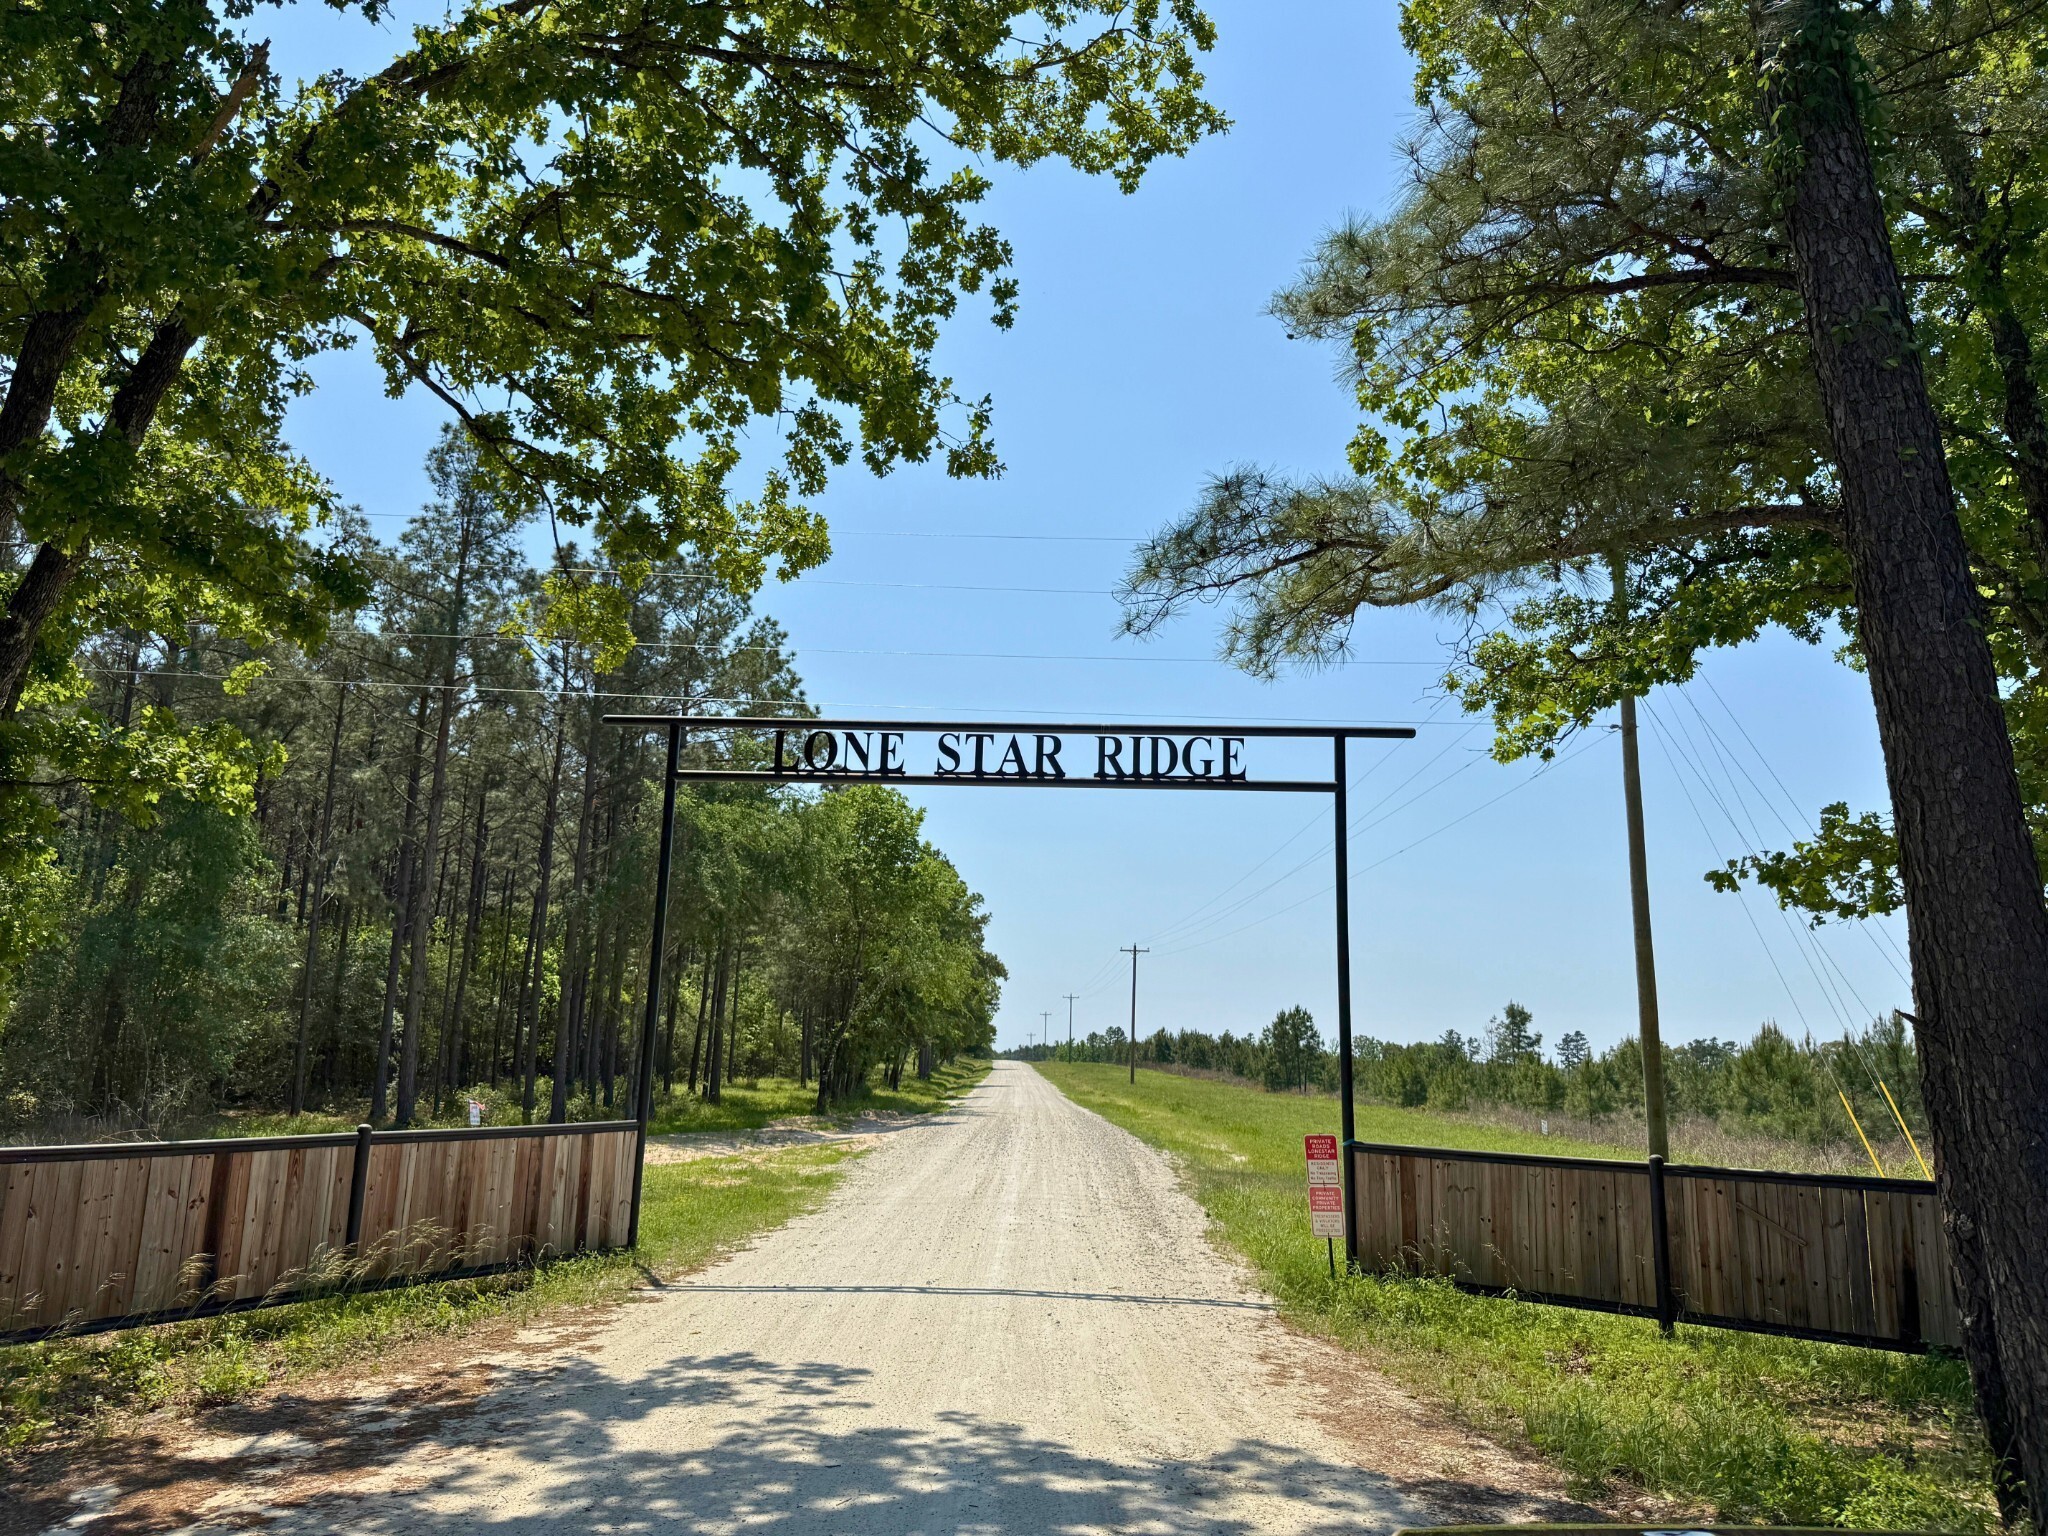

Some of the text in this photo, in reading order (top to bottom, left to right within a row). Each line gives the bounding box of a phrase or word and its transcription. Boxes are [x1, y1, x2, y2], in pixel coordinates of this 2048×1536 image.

[766, 730, 1246, 781] LONE STAR RIDGE
